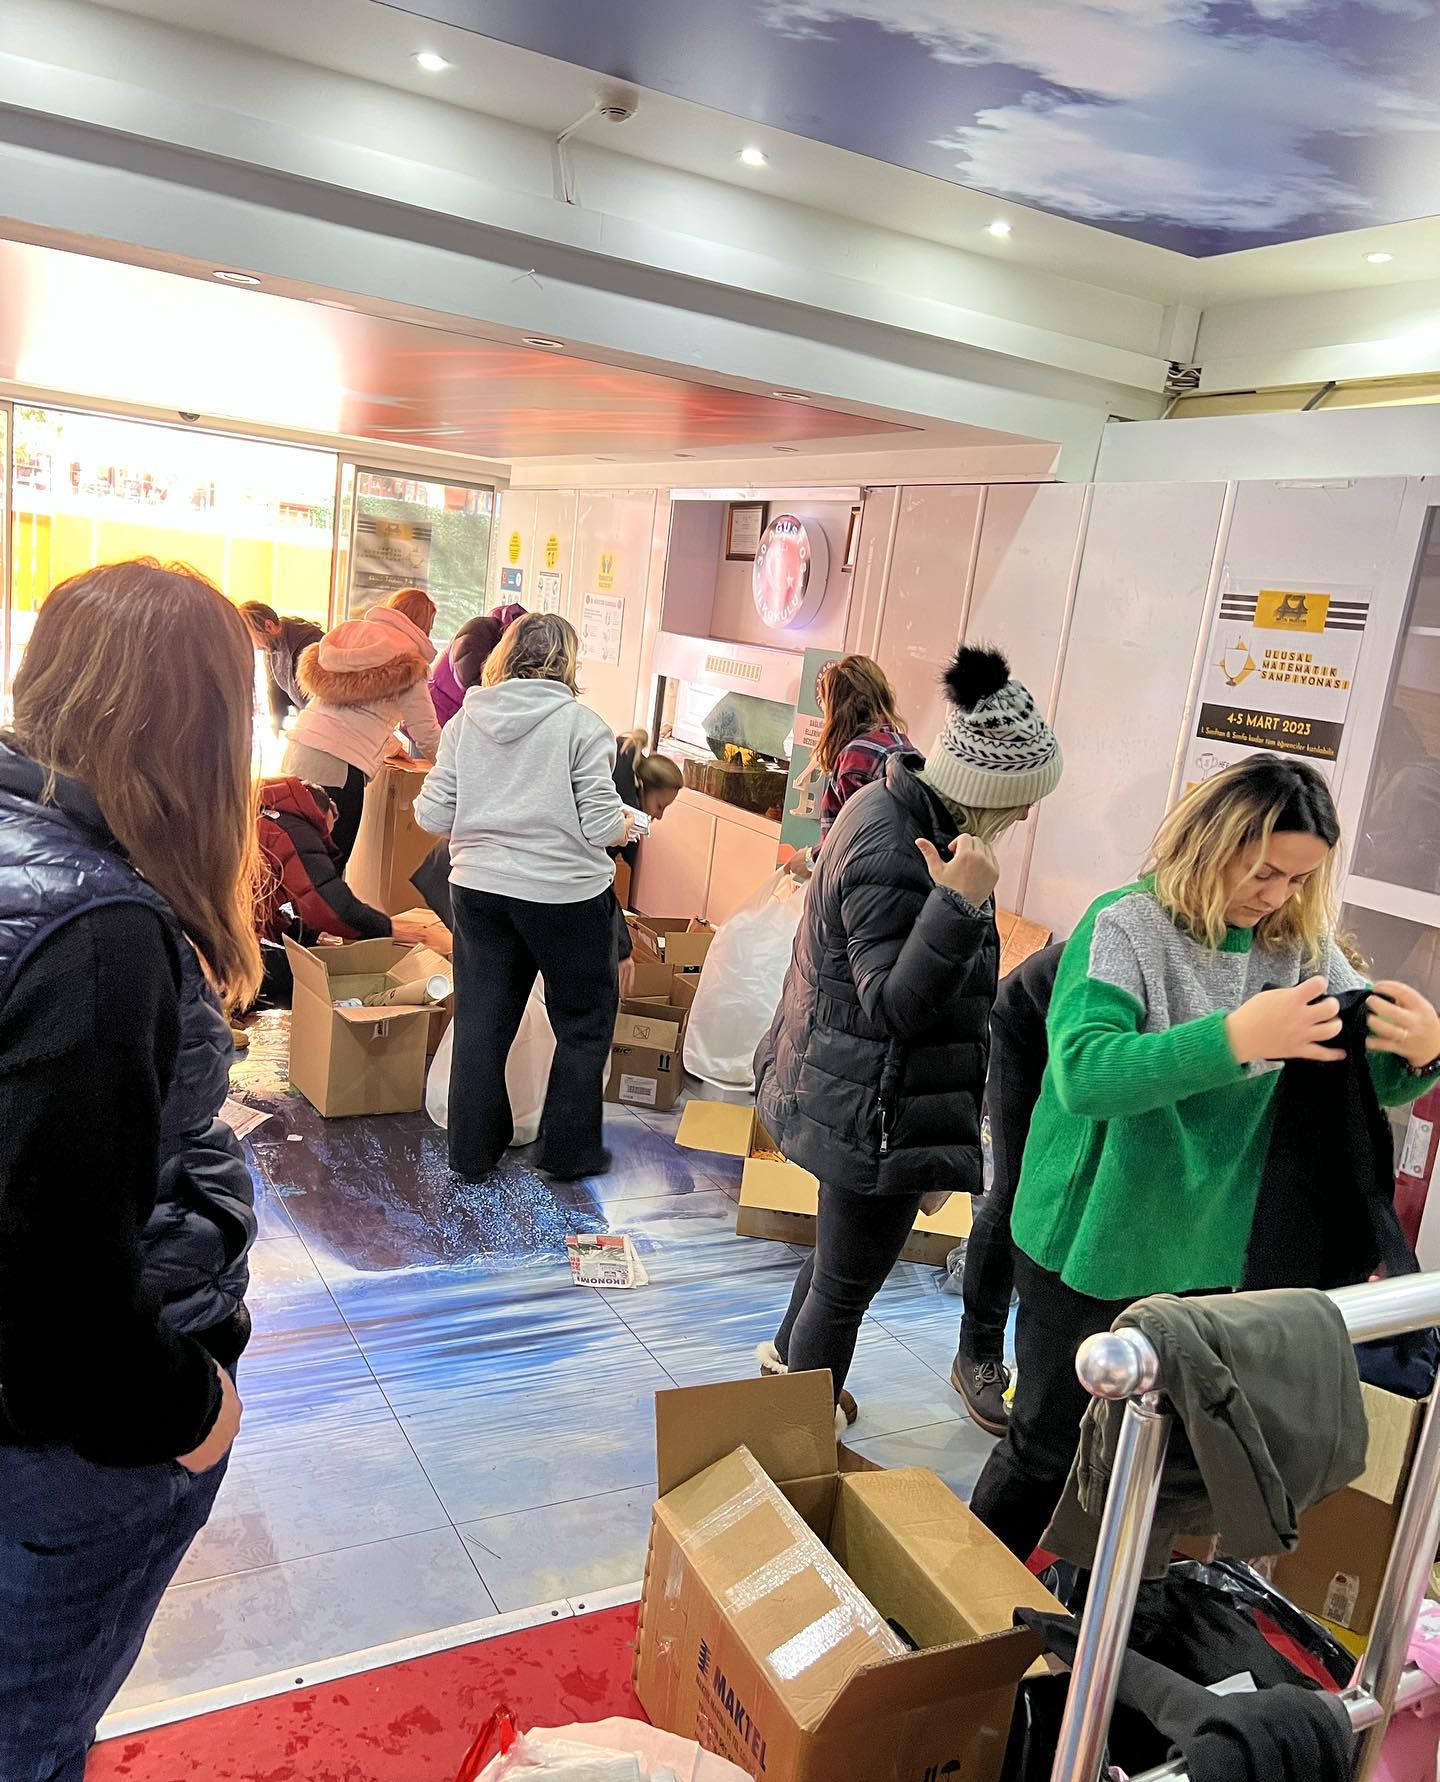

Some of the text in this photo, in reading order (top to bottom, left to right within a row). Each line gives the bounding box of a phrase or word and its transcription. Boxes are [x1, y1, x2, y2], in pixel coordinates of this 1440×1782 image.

[1265, 649, 1312, 663] ULUSAL
[1246, 713, 1281, 731] MART
[1282, 720, 1311, 736] 2023
[713, 1665, 767, 1773] MAKTEL
